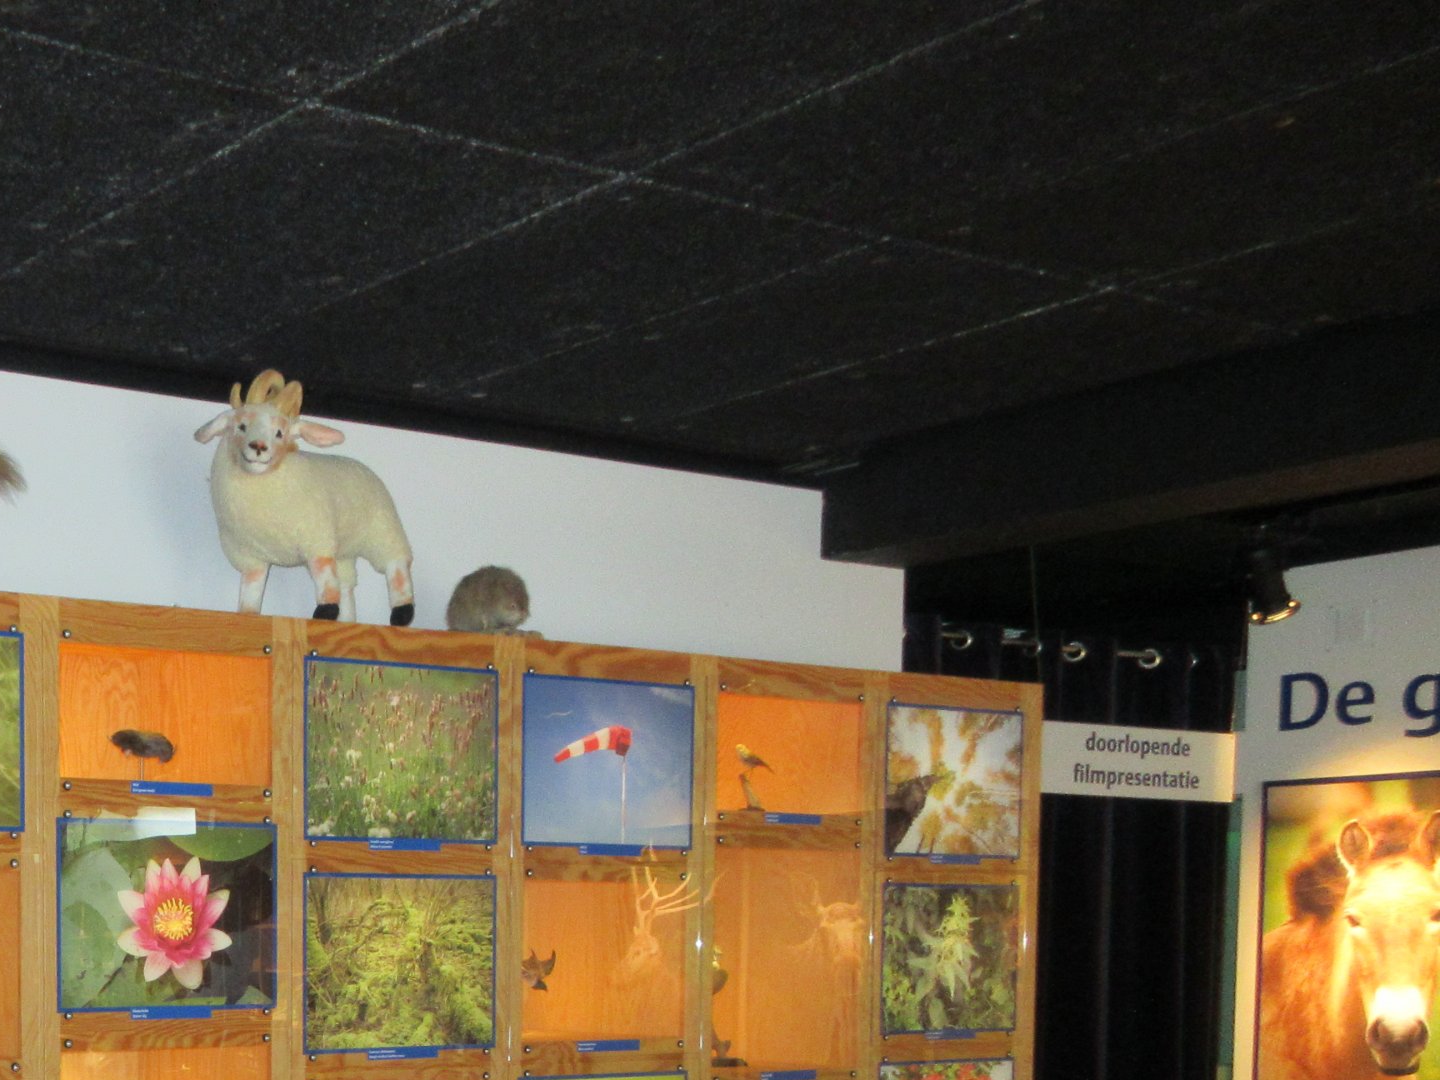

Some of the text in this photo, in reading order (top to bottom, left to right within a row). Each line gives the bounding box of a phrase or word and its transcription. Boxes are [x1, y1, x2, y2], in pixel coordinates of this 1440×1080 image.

[1278, 671, 1375, 732] De
[1085, 731, 1191, 759] doorlopende
[1073, 763, 1200, 790] filmpresentatie
